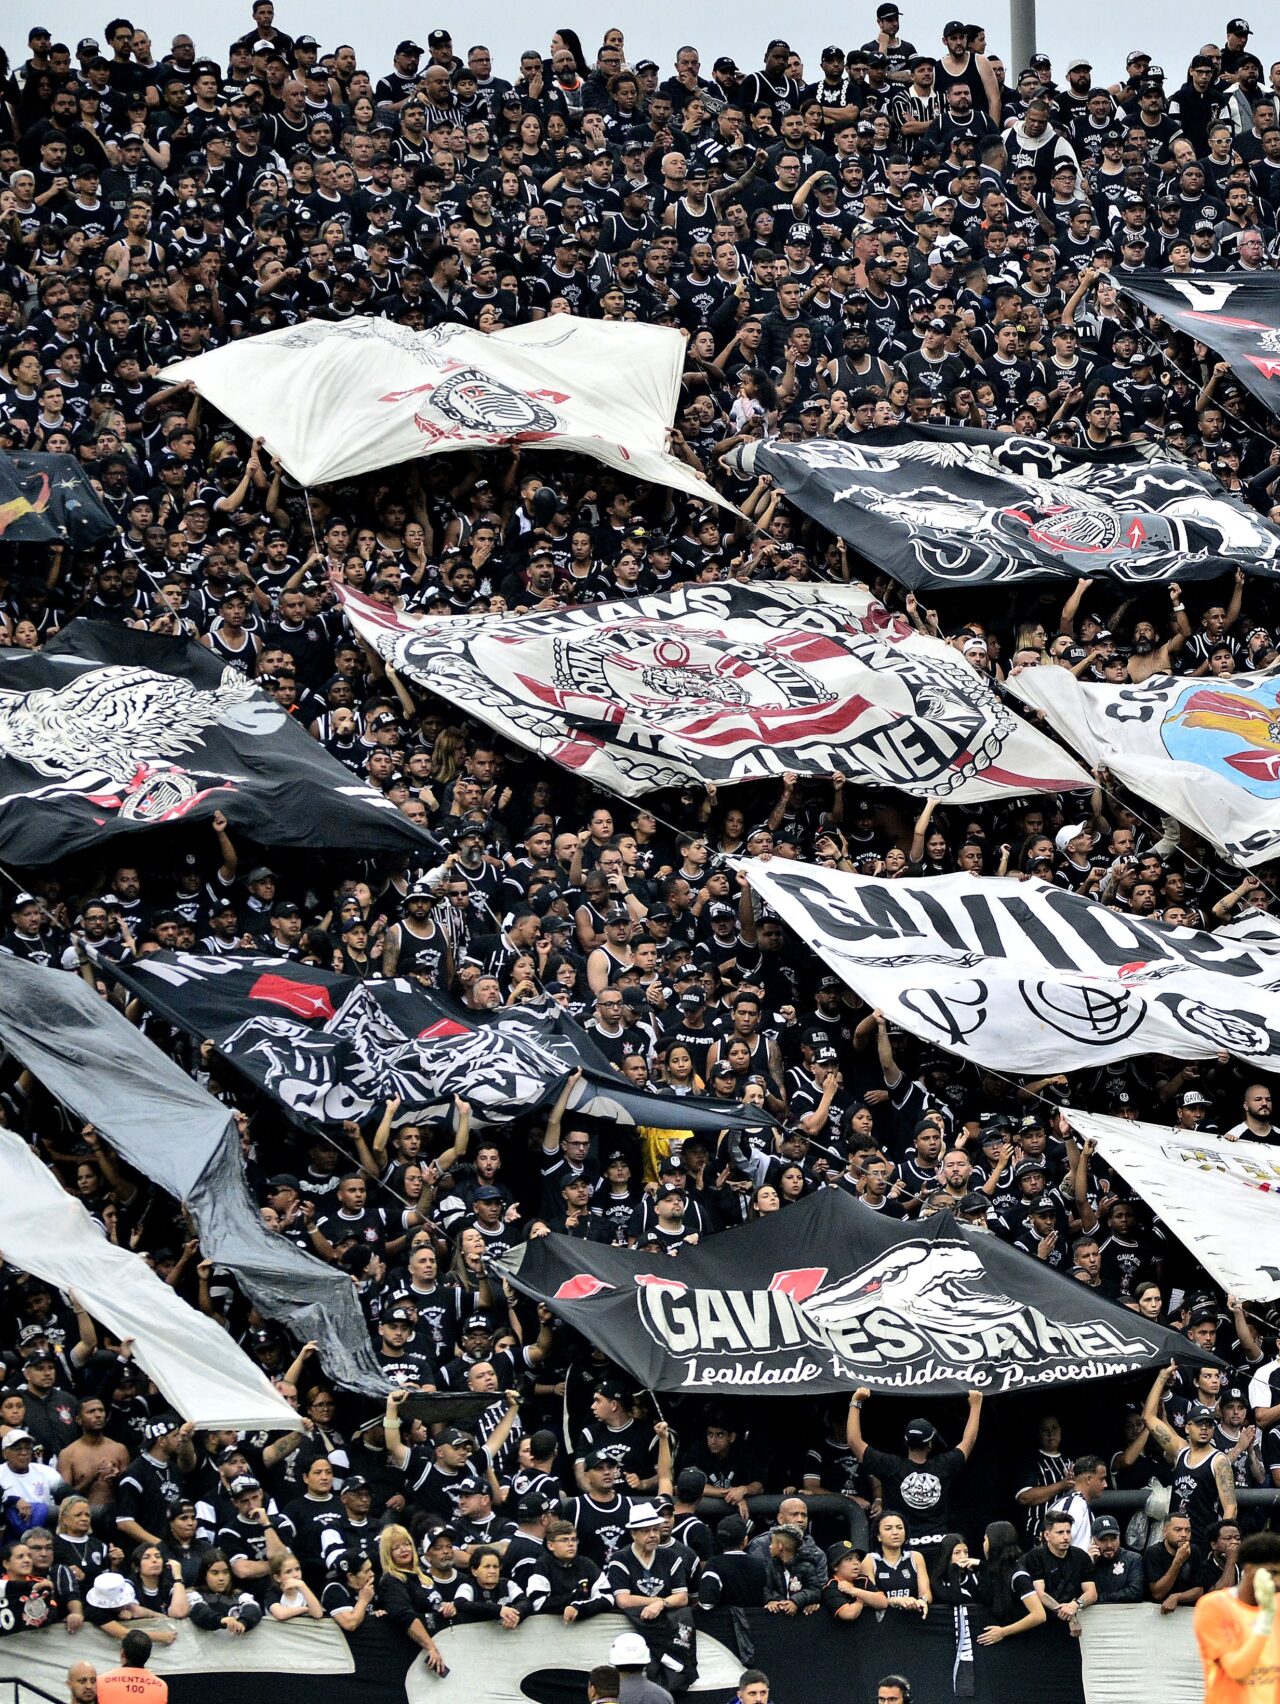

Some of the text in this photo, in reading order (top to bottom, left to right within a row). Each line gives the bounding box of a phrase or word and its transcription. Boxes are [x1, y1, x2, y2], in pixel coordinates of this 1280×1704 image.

[606, 1205, 633, 1214] GAVIÕES
[1116, 1254, 1141, 1264] GAVIÕES
[681, 1356, 823, 1387] Lealdade
[1174, 1475, 1198, 1489] GAVIÕES
[595, 1526, 626, 1536] GAVIÕES
[104, 1675, 163, 1687] ORIENTAÇÃO
[126, 1684, 145, 1694] 100
